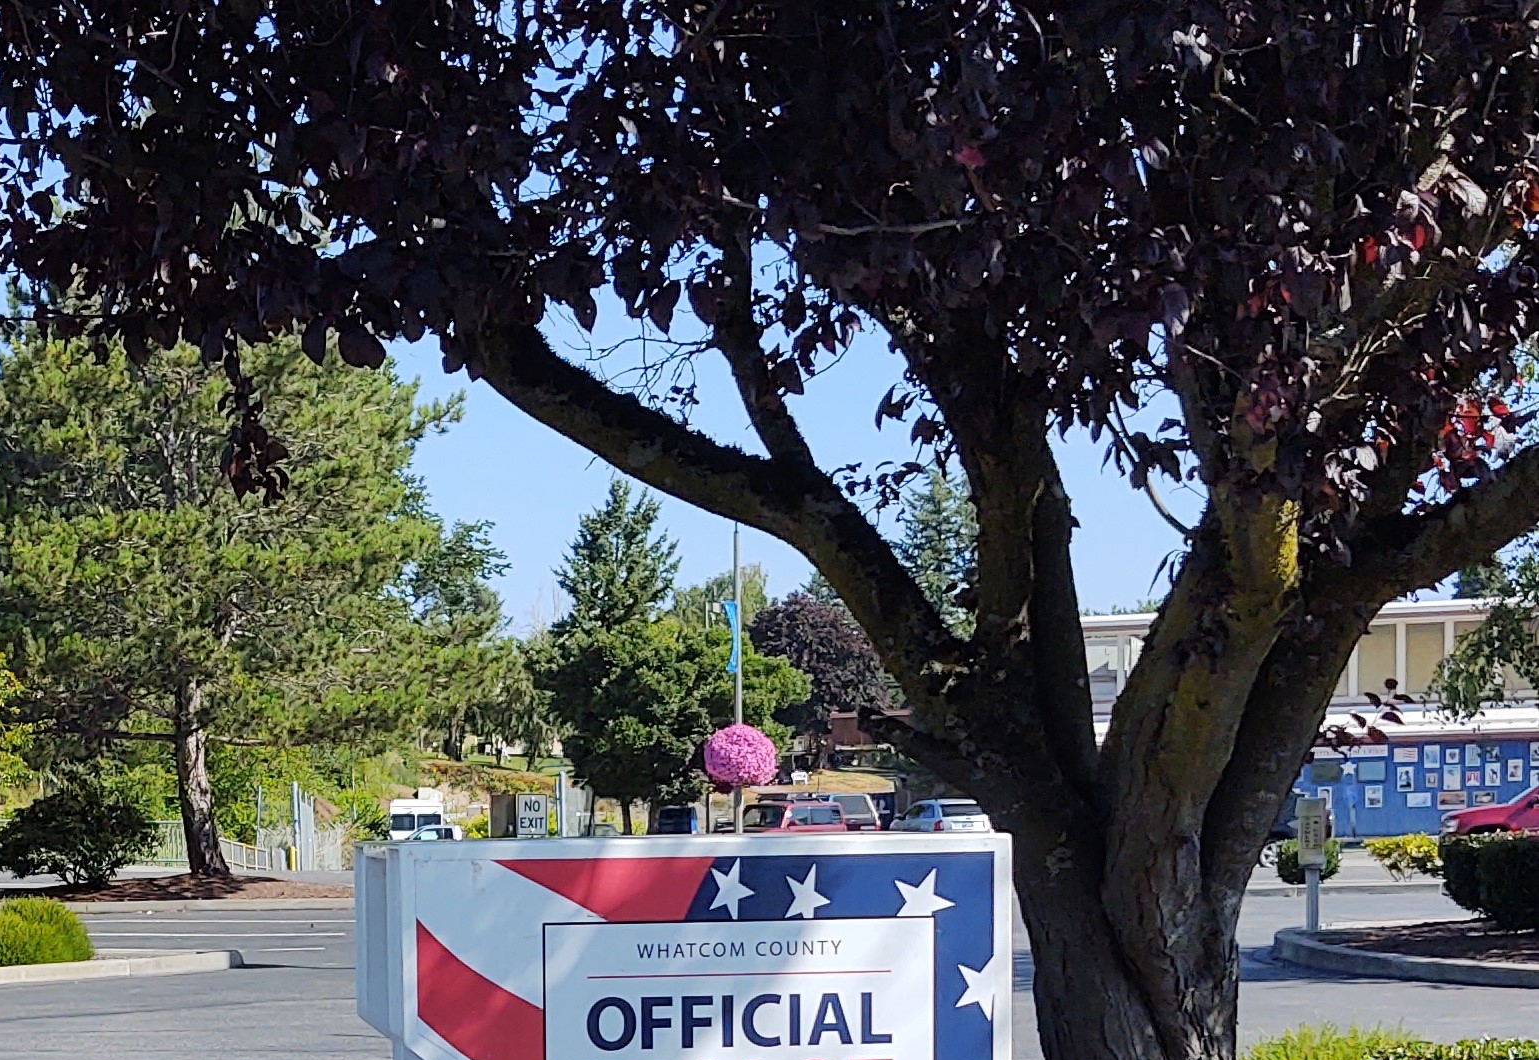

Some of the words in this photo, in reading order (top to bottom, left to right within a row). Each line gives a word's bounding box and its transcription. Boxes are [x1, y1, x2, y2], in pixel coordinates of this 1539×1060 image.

[524, 800, 540, 813] NO
[520, 817, 544, 829] EXIT
[636, 941, 746, 959] WHATCOM
[755, 939, 843, 957] COUNTY
[586, 991, 893, 1052] OFFICIAL
